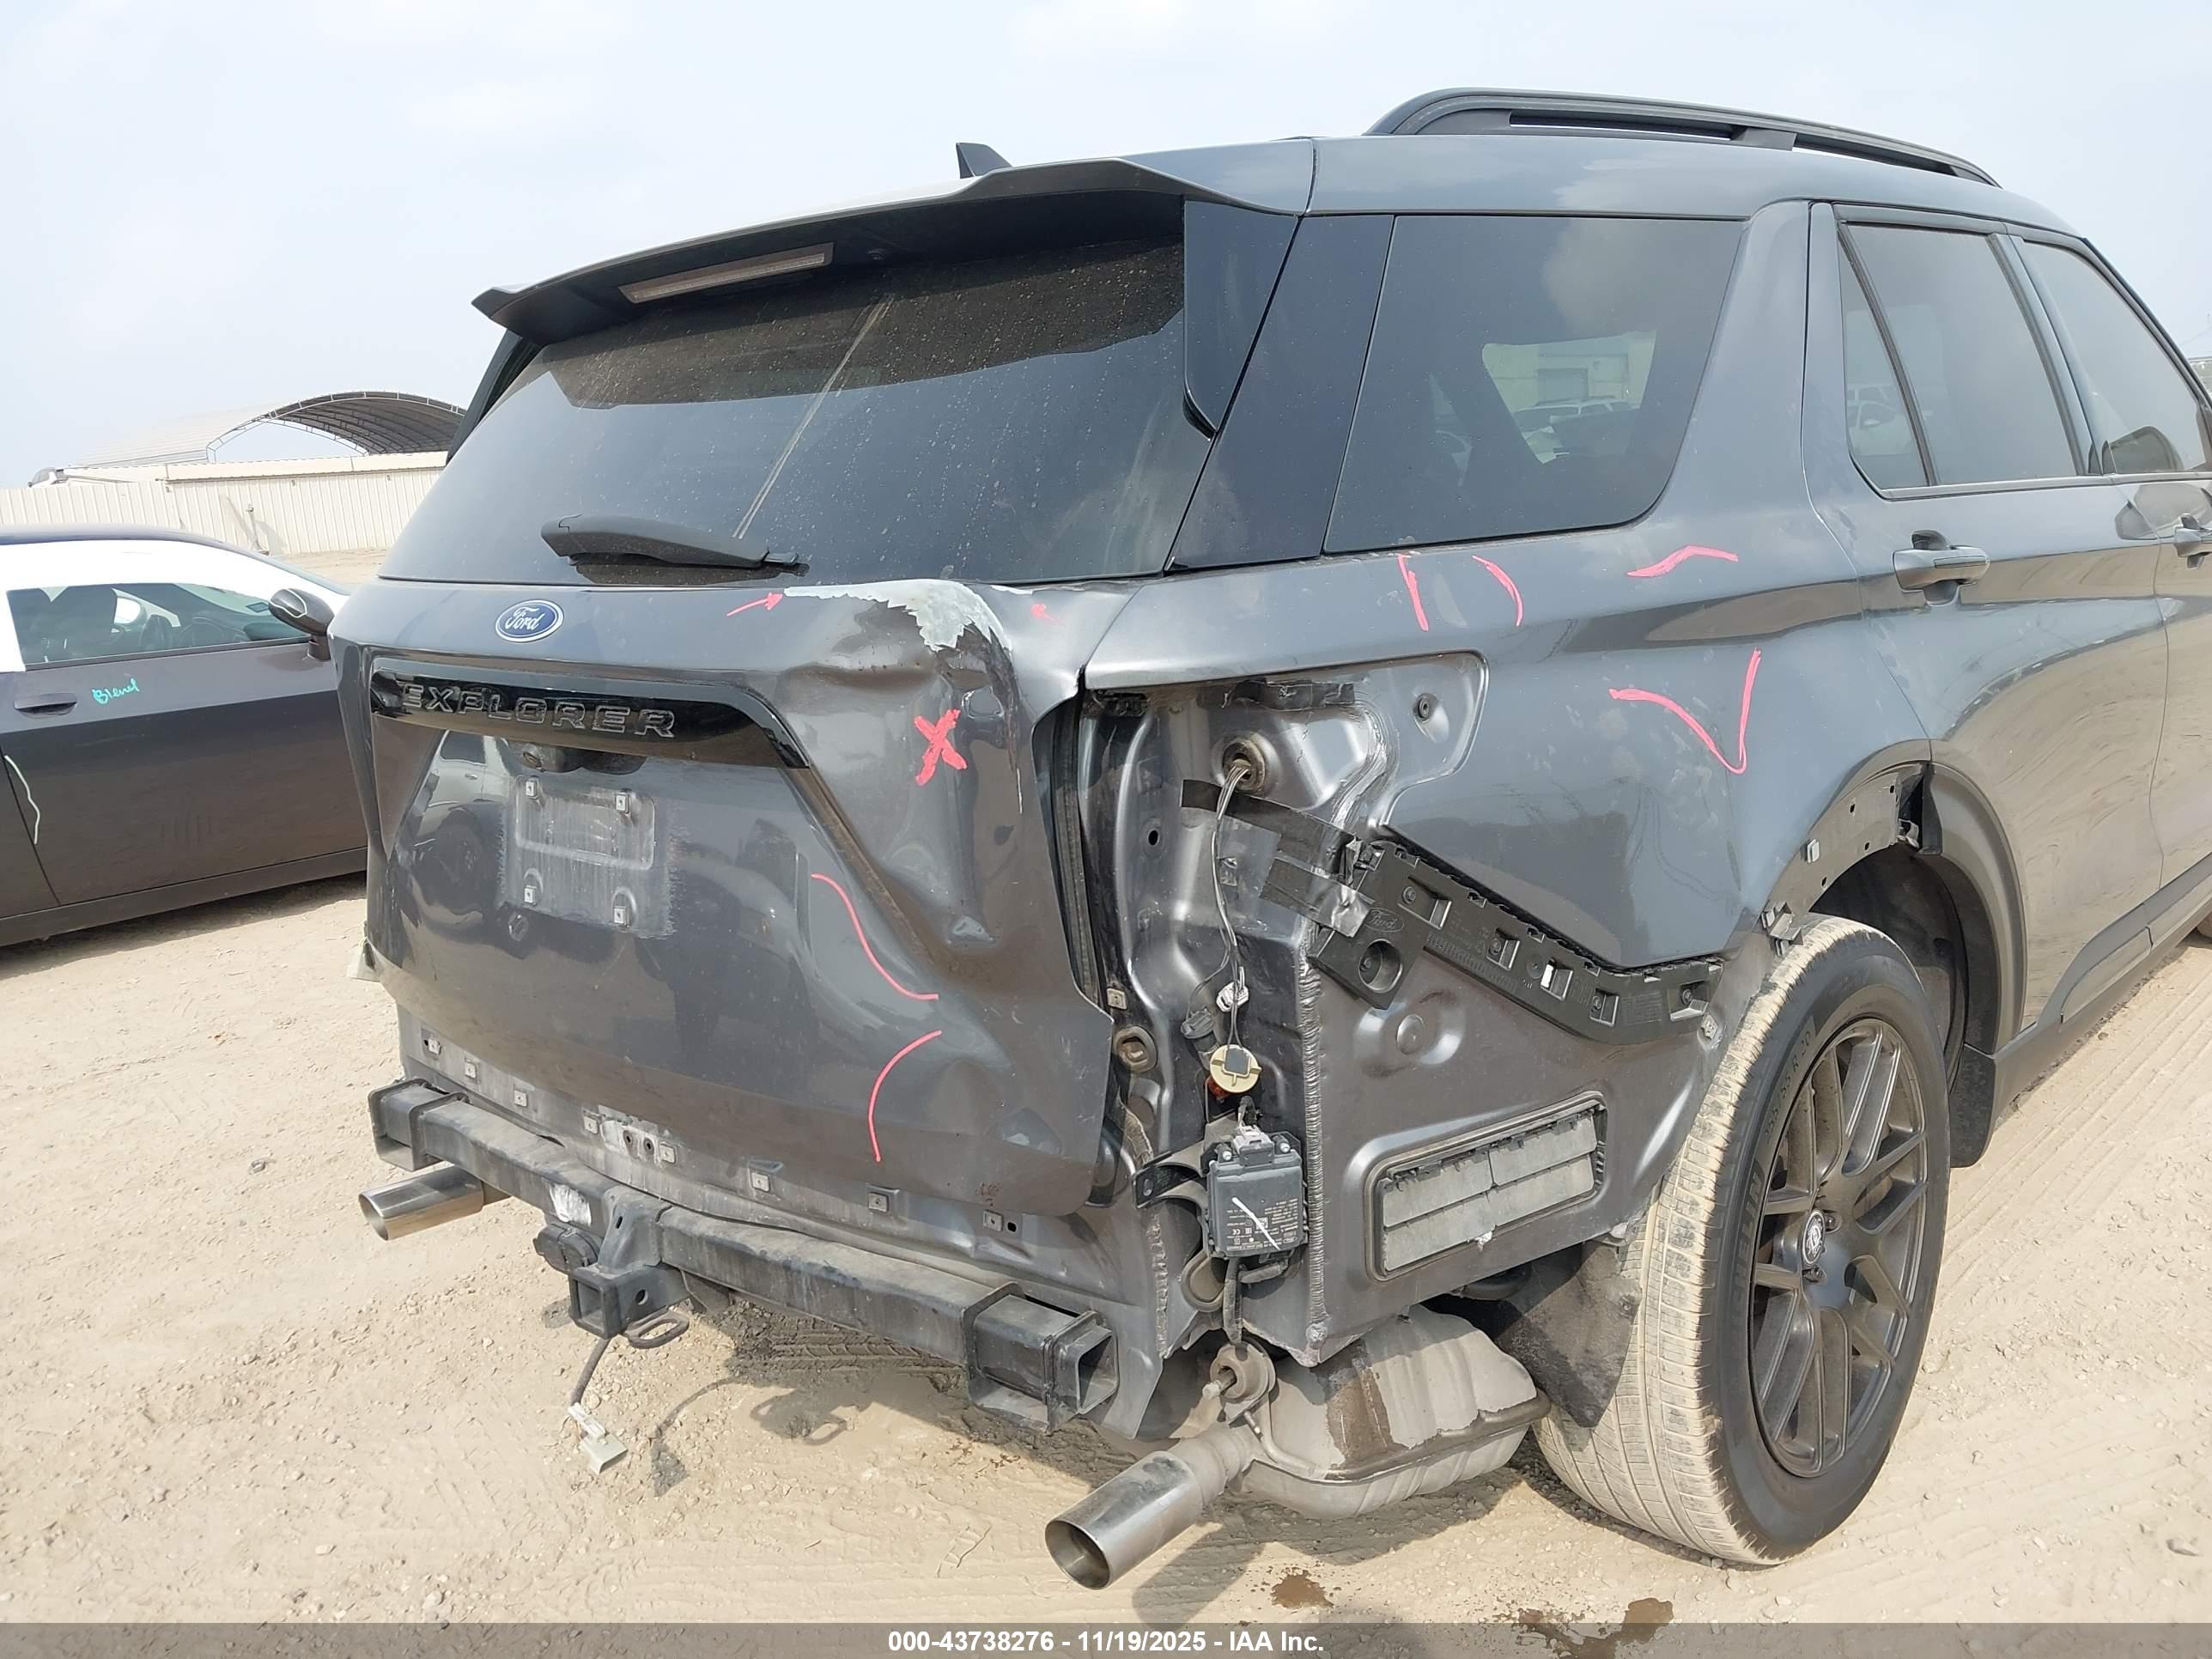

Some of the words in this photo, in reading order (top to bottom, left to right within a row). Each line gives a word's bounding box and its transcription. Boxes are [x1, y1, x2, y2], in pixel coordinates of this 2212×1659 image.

[505, 606, 545, 630] Ford
[92, 678, 140, 704] Blend
[402, 684, 675, 738] EXPLORER
